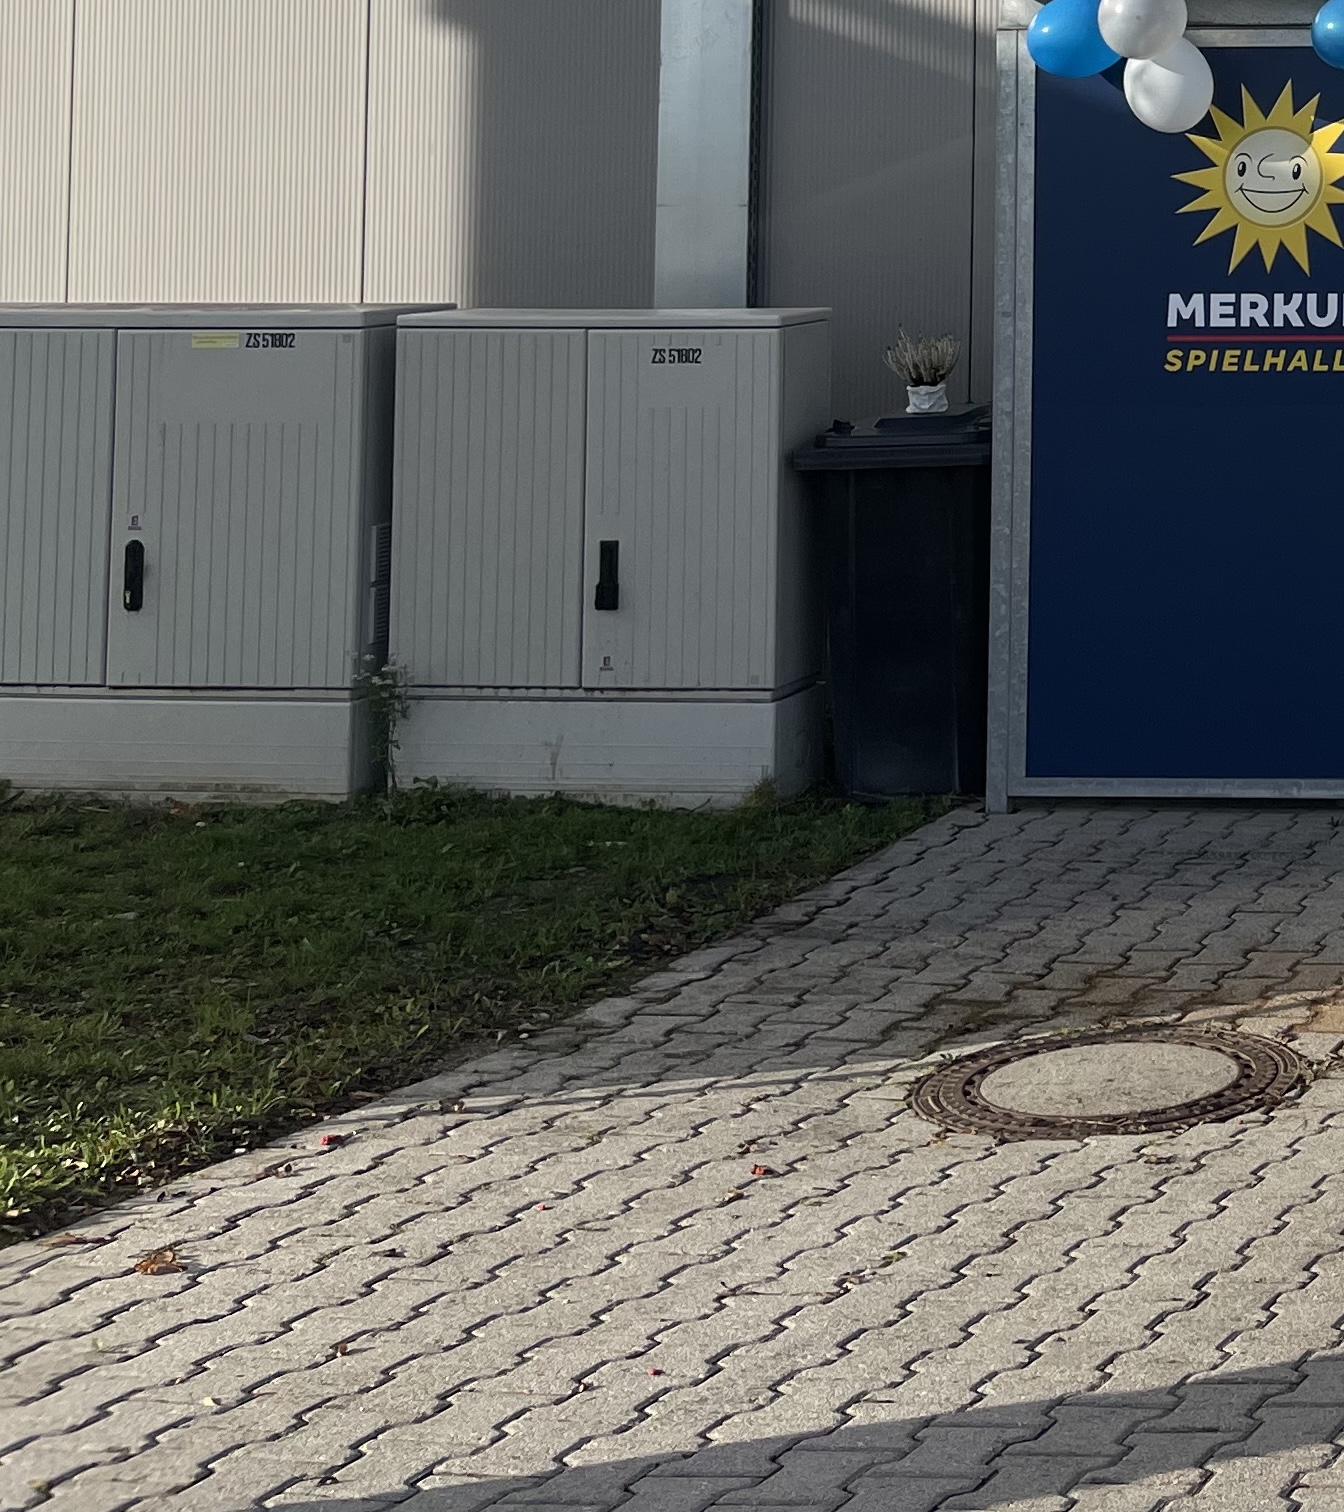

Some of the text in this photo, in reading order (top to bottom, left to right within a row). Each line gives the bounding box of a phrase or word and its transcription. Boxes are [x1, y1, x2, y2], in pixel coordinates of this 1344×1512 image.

[245, 333, 261, 348] ZS
[262, 333, 296, 348] 51802
[651, 348, 702, 364] ZS 51802
